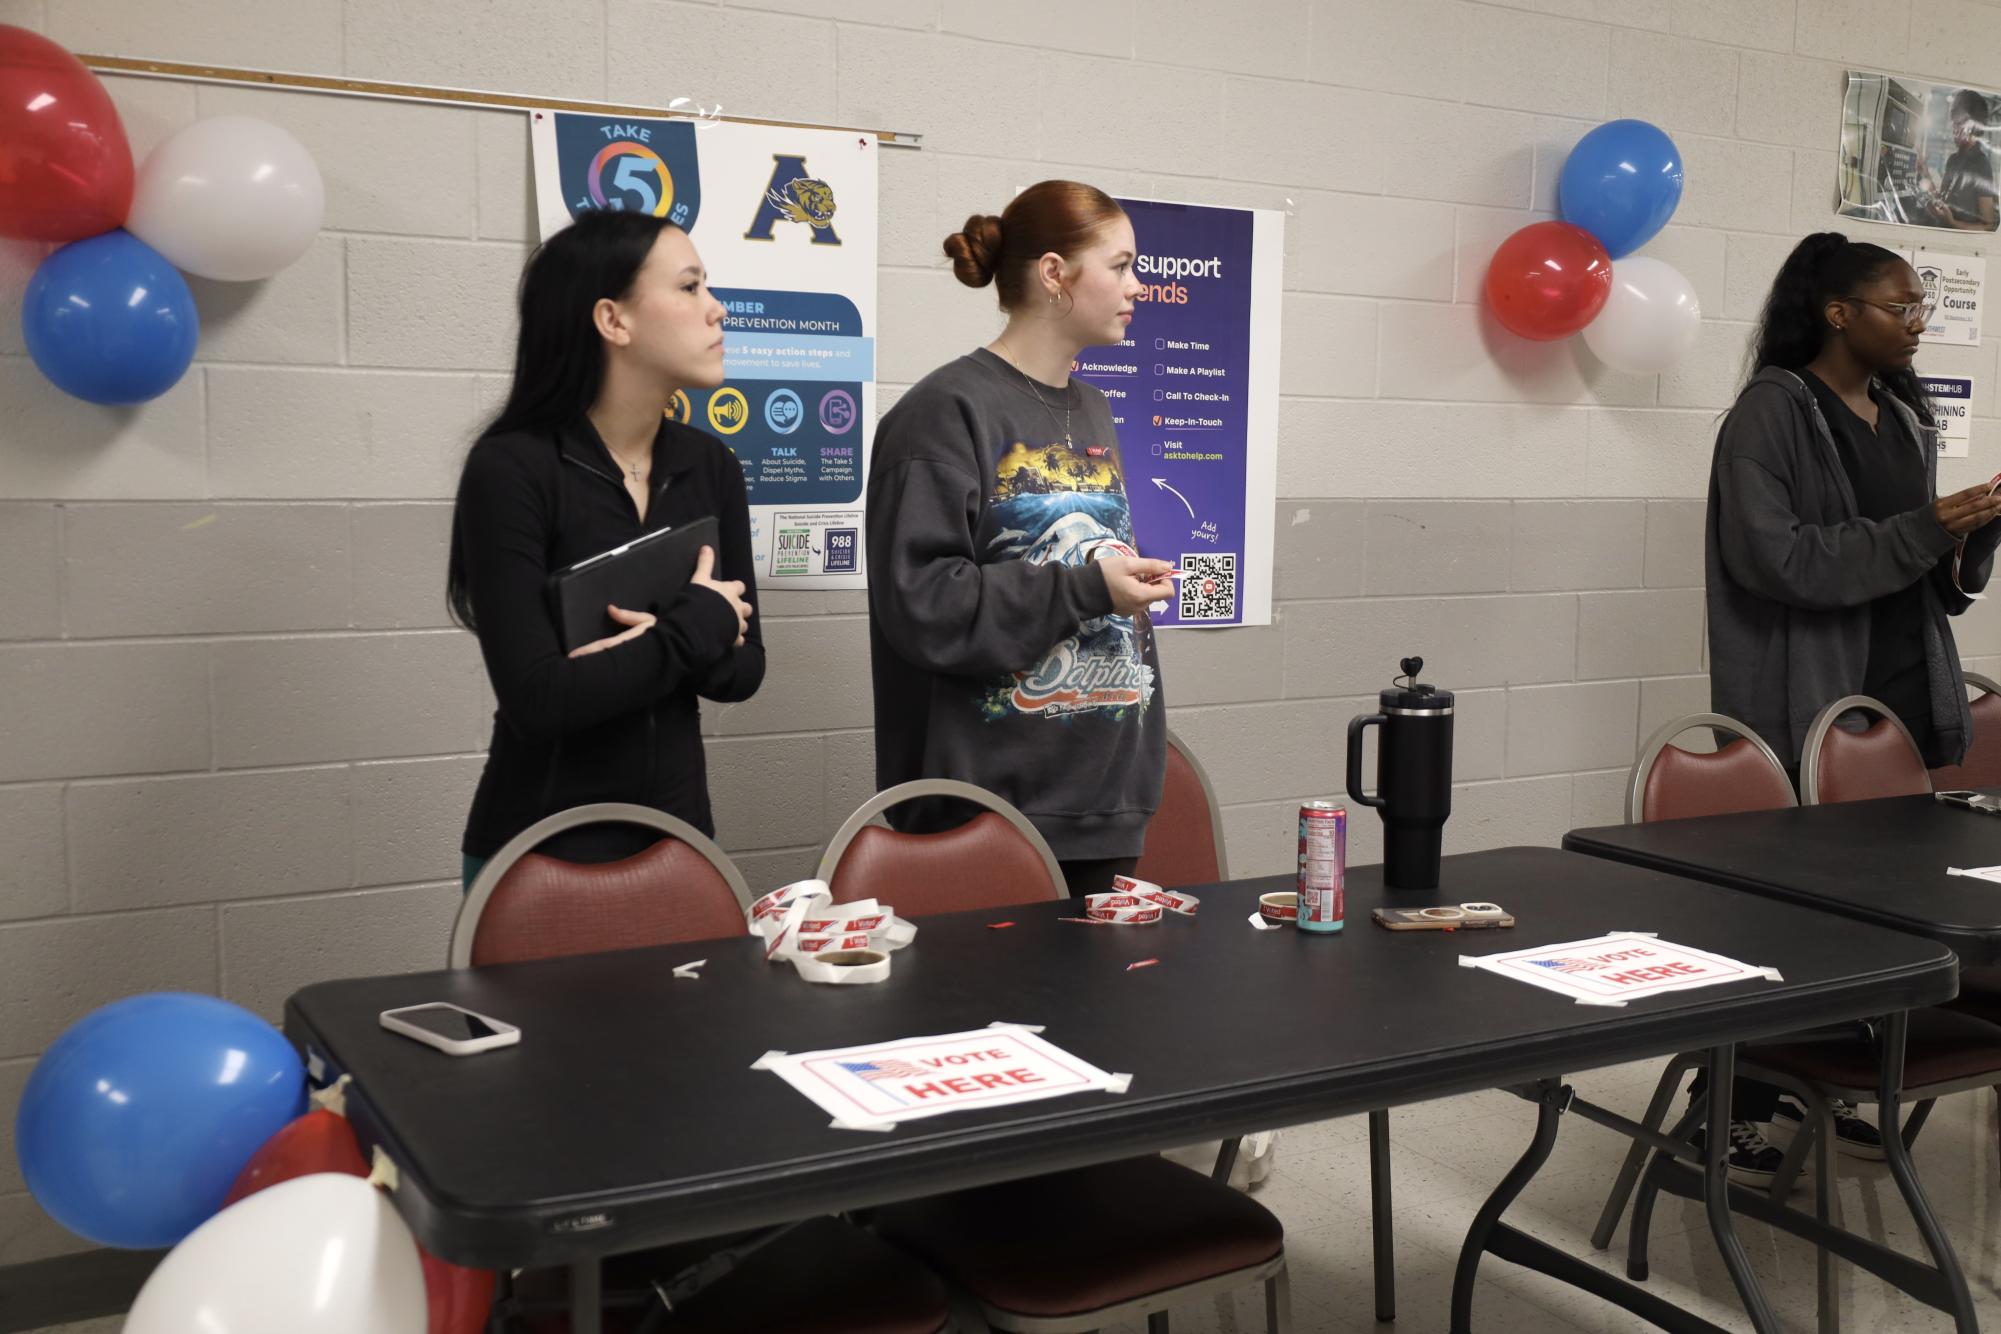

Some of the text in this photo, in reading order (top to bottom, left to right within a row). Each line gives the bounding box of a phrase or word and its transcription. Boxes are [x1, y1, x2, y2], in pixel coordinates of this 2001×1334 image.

[600, 124, 651, 142] TAKE
[1136, 254, 1222, 279] support
[1956, 268, 1969, 277] Early
[1942, 276, 1980, 287] Postsecondary
[1943, 285, 1976, 296] Opportunity
[1943, 295, 1976, 310] Course
[723, 316, 840, 331] PREVENTION MONTH
[1167, 341, 1210, 350] Make Time
[742, 346, 749, 355] 5
[751, 347, 774, 357] easy
[775, 347, 806, 357] action
[808, 349, 833, 359] steps
[1082, 362, 1138, 374] Acknowledge
[1166, 366, 1226, 377] Make A Playlist
[1166, 391, 1230, 402] Call To Check-In
[1164, 416, 1223, 427] Keep-In-Touch
[1164, 441, 1182, 449] Visit
[771, 447, 797, 456] TALK
[820, 447, 853, 456] SHARE
[1164, 452, 1223, 462] asktohelp.com
[785, 475, 807, 483] Stigma
[1201, 521, 1217, 532] Add
[778, 534, 810, 550] SUICIDE
[832, 536, 851, 548] 988
[1191, 529, 1219, 544] yours!
[1590, 948, 1657, 963] VOTE
[1601, 962, 1707, 984] HERE
[919, 1048, 1011, 1067] VOTE
[904, 1067, 1046, 1099] HERE
